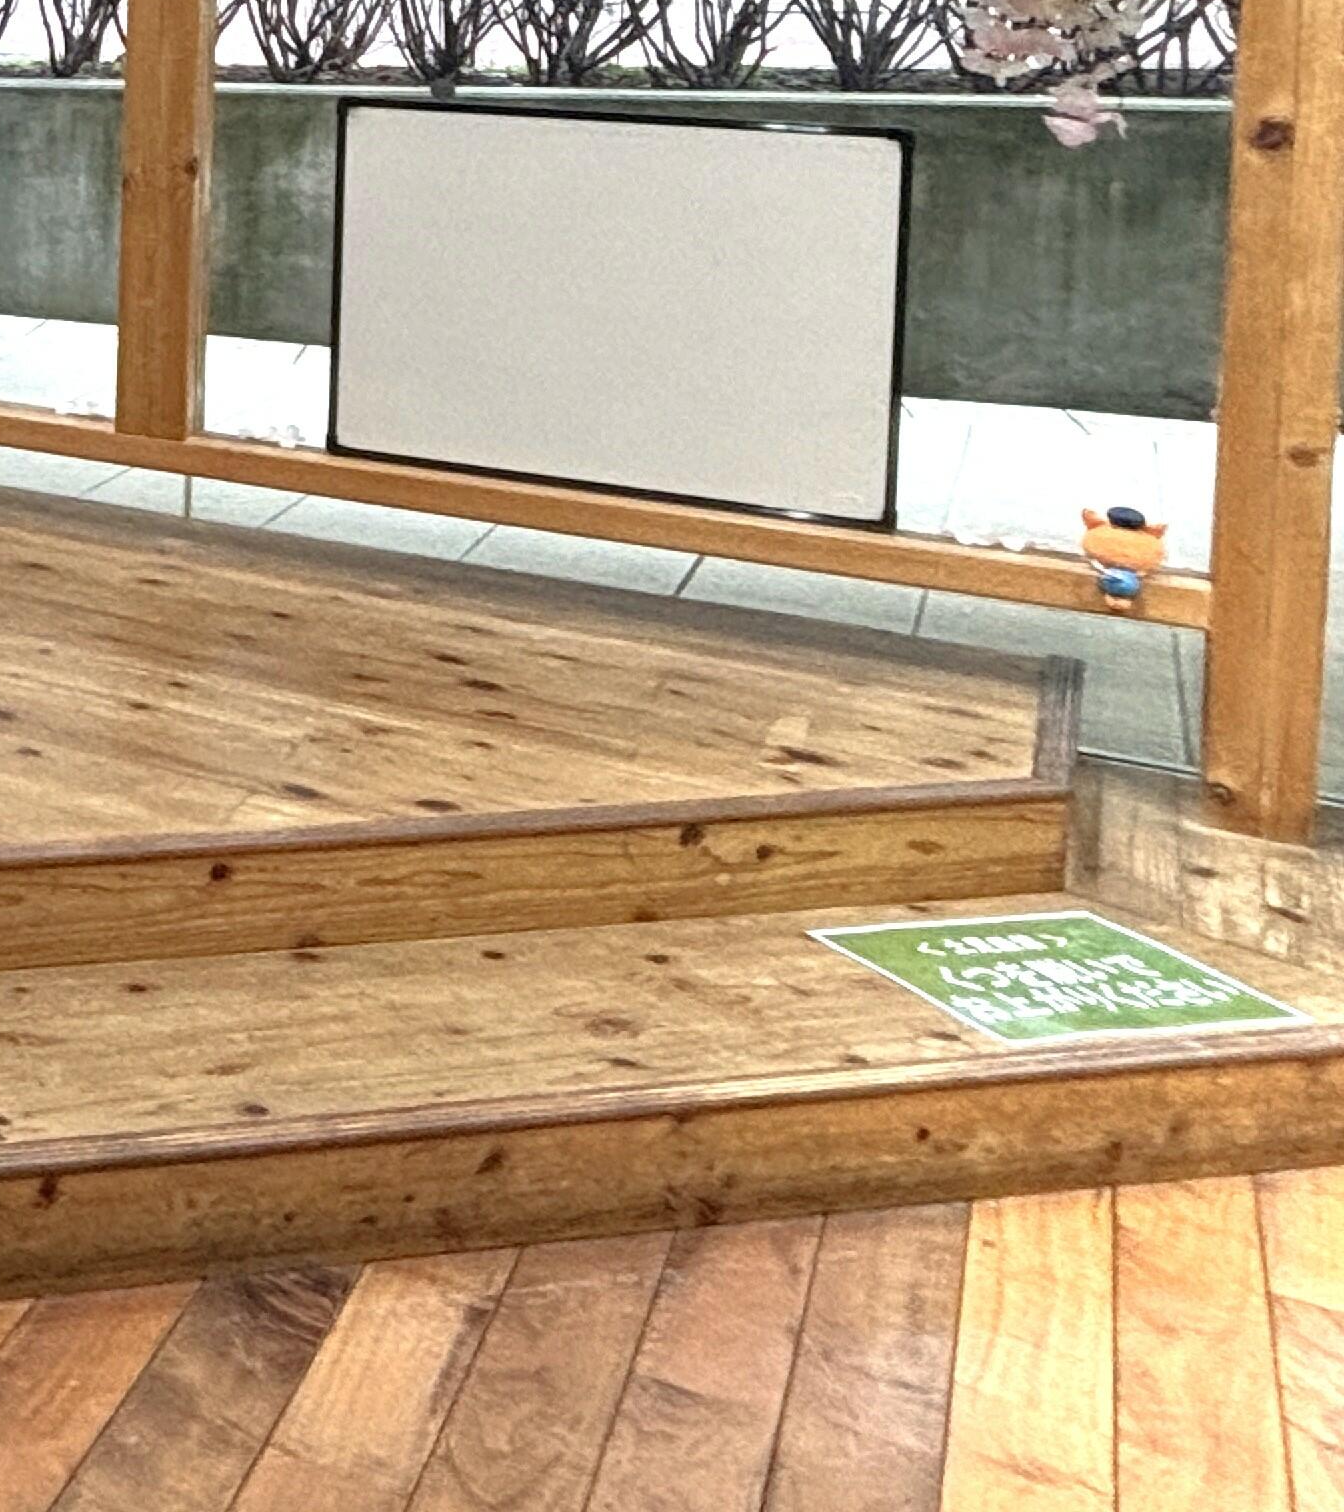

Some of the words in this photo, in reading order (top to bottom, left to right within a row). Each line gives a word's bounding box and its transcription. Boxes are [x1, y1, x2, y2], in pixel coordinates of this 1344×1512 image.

[950, 976, 1242, 1024] お上がりください
